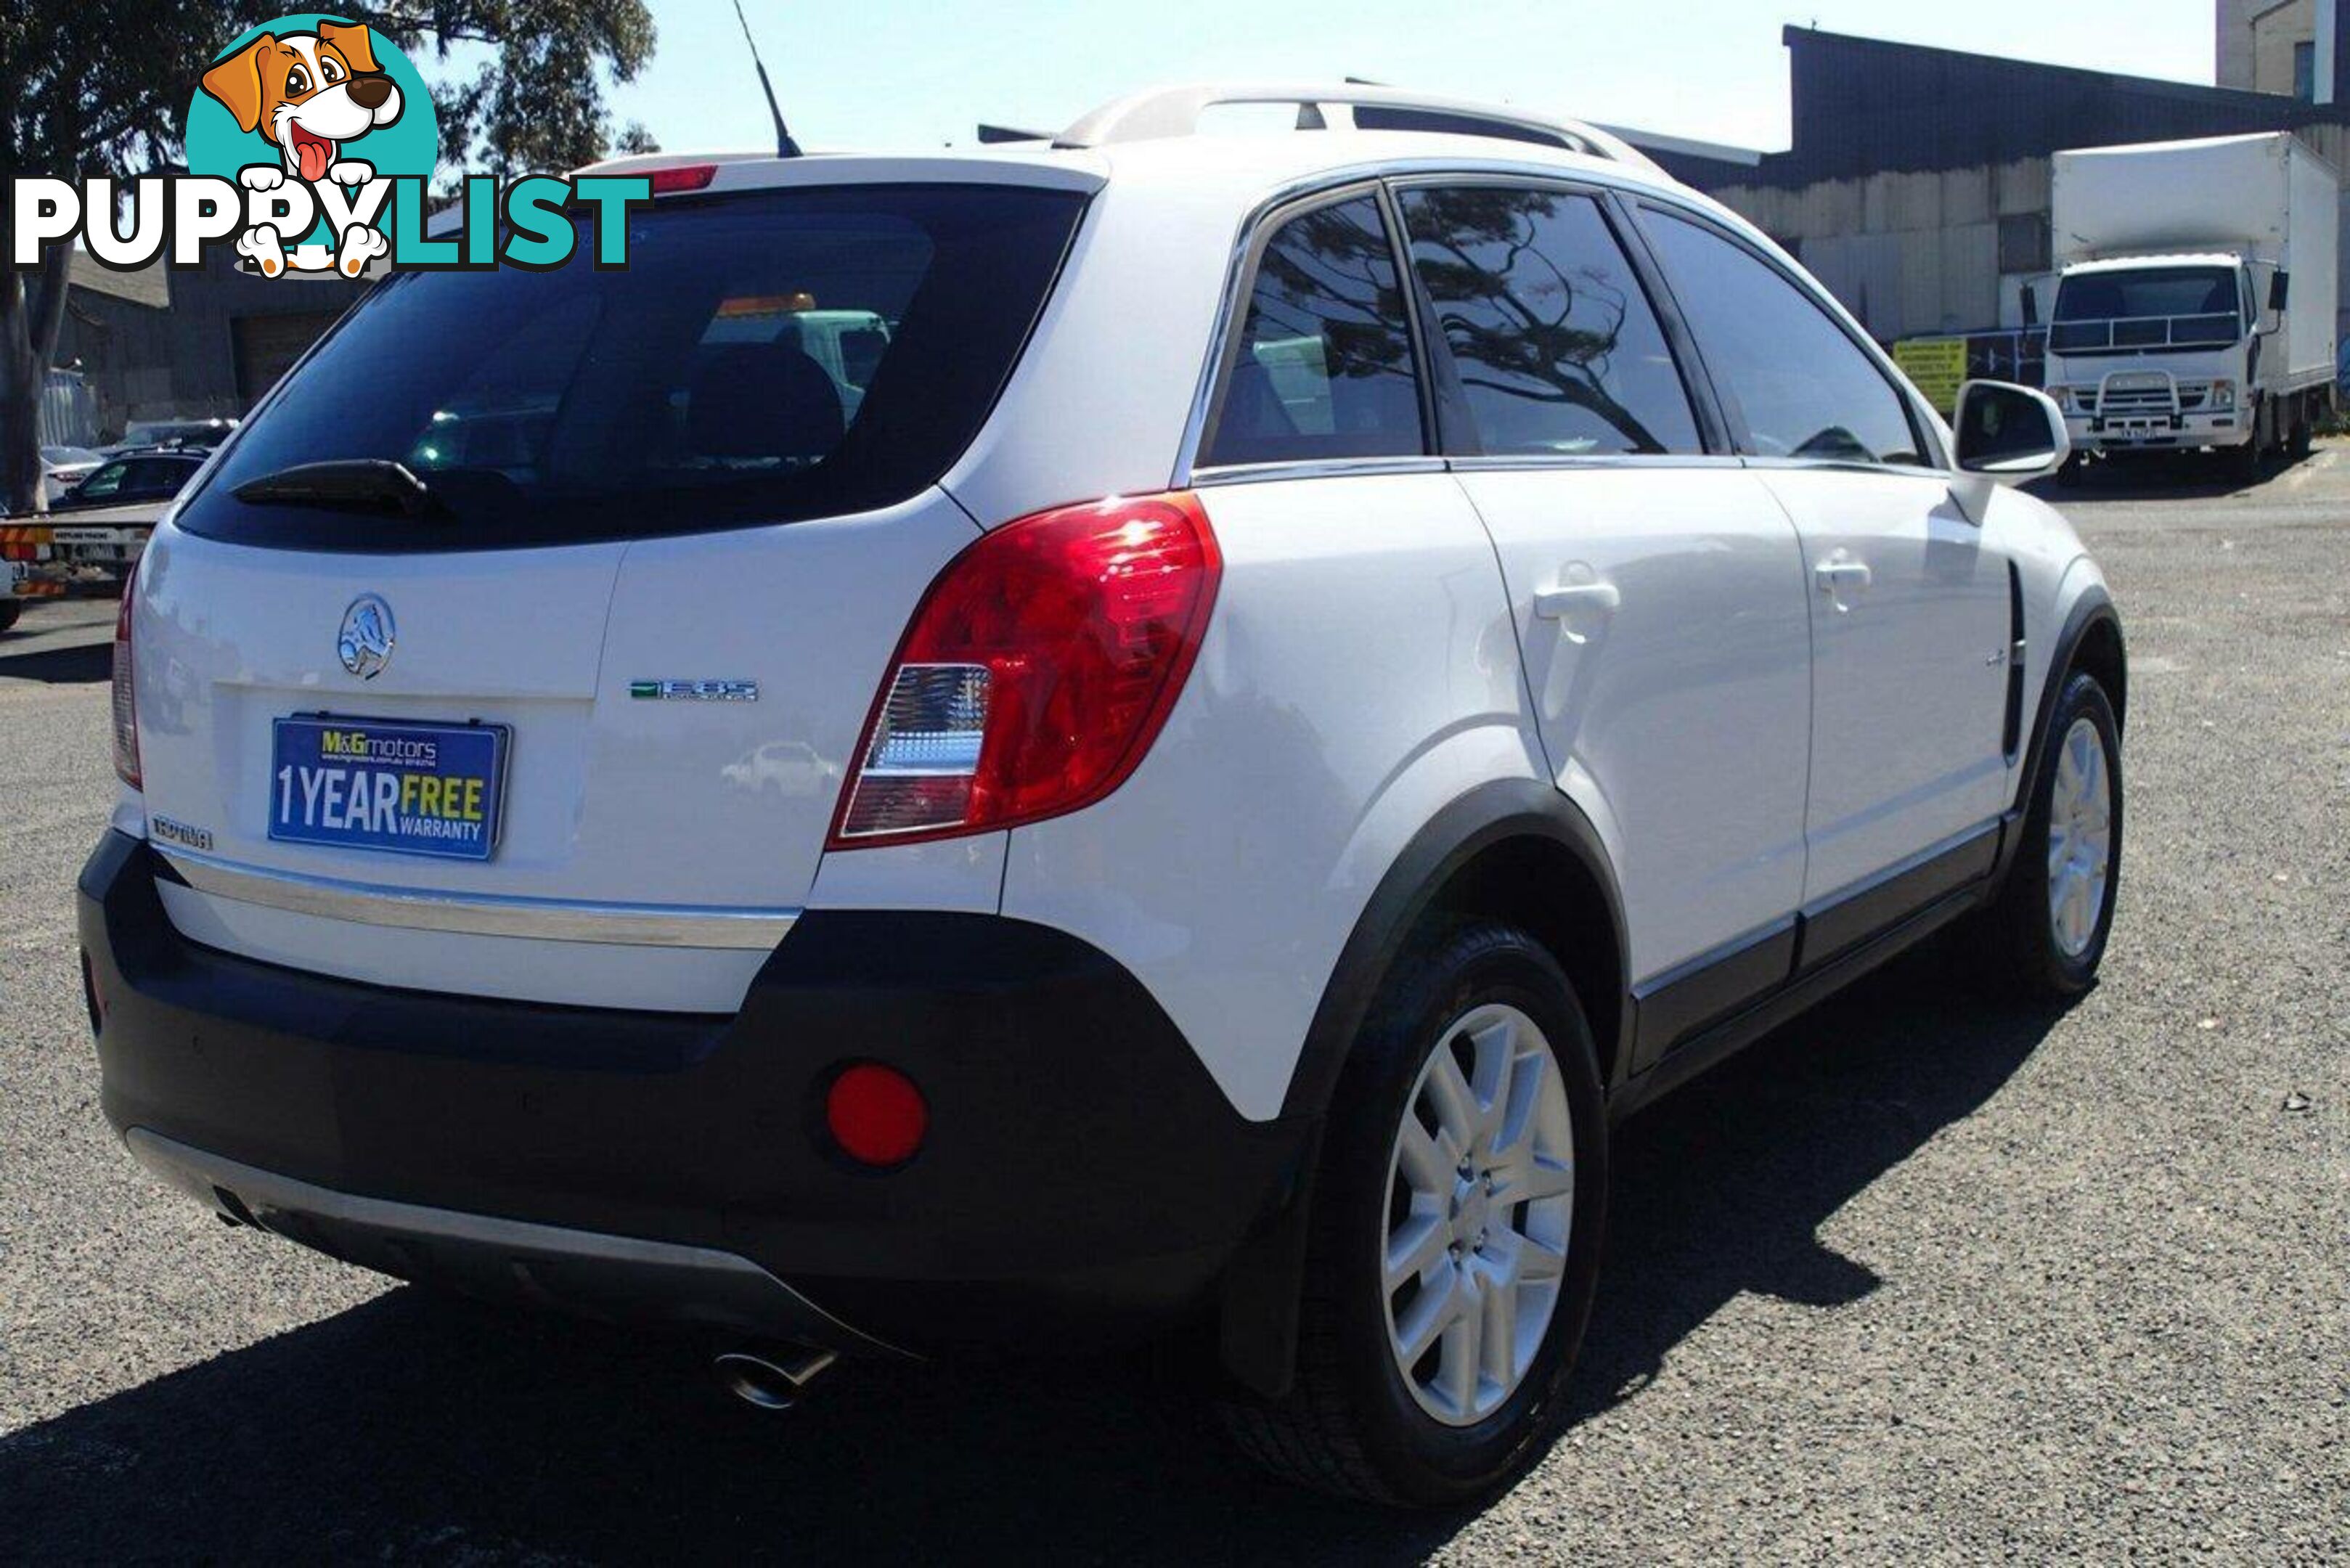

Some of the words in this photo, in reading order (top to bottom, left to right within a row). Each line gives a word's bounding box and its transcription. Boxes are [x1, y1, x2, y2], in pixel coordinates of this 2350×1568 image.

[278, 764, 293, 824] 1
[299, 767, 399, 835] YEAR
[401, 774, 484, 821] FREE
[399, 816, 482, 842] WARRANTY
